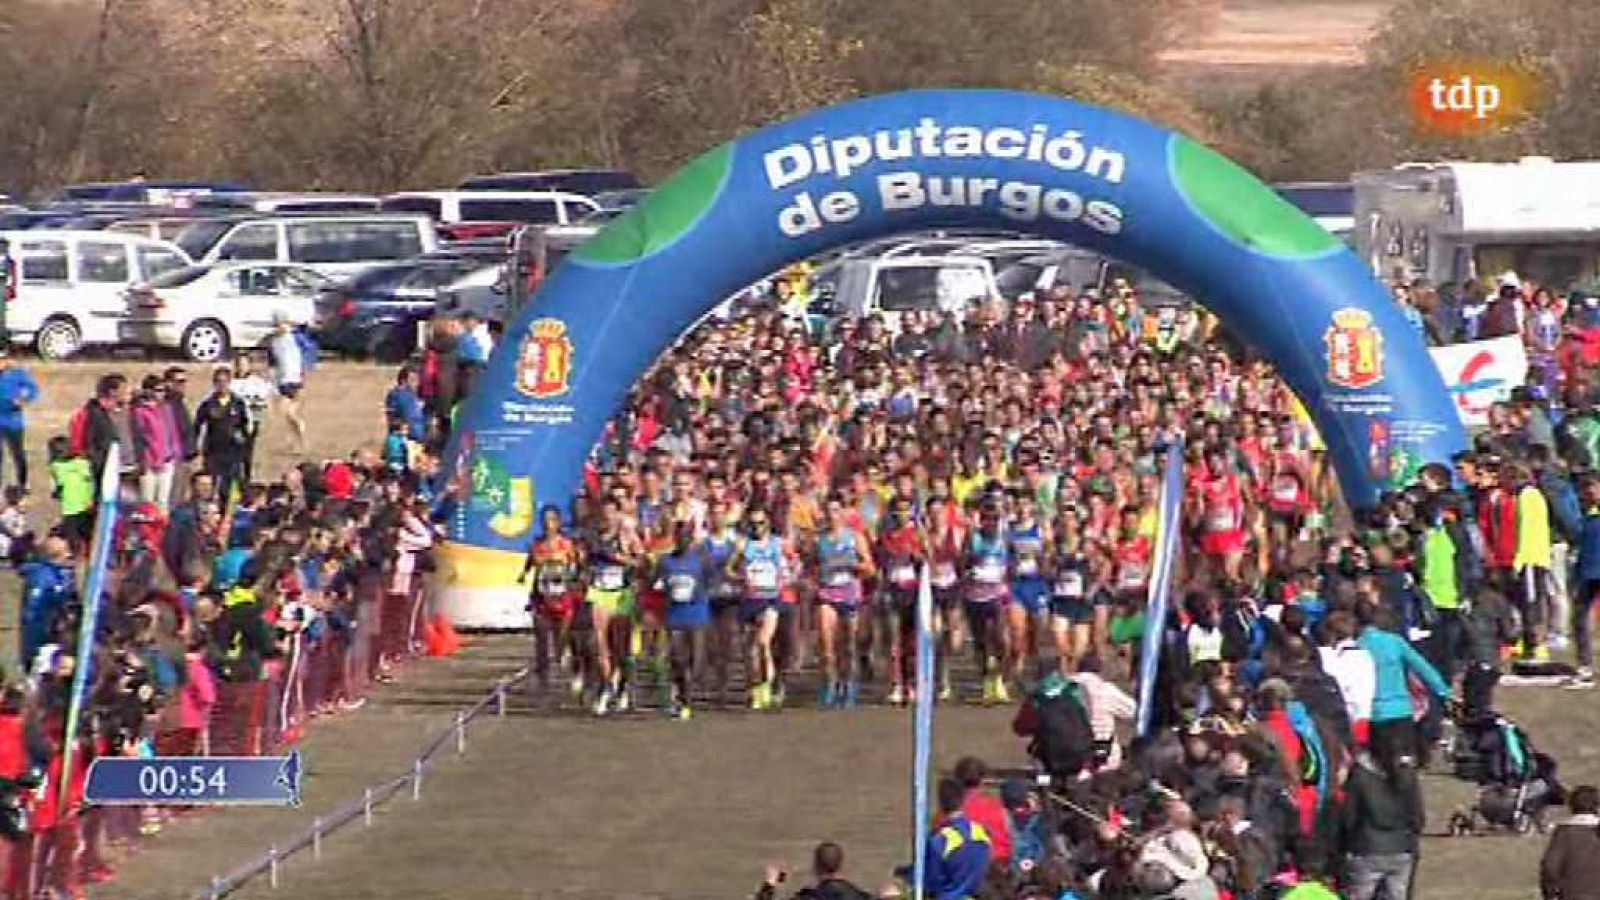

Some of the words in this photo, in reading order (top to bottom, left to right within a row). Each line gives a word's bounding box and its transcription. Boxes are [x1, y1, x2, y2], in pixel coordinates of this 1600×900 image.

[763, 117, 1126, 189] Diputación
[778, 190, 860, 238] de
[876, 171, 1124, 235] Burgos
